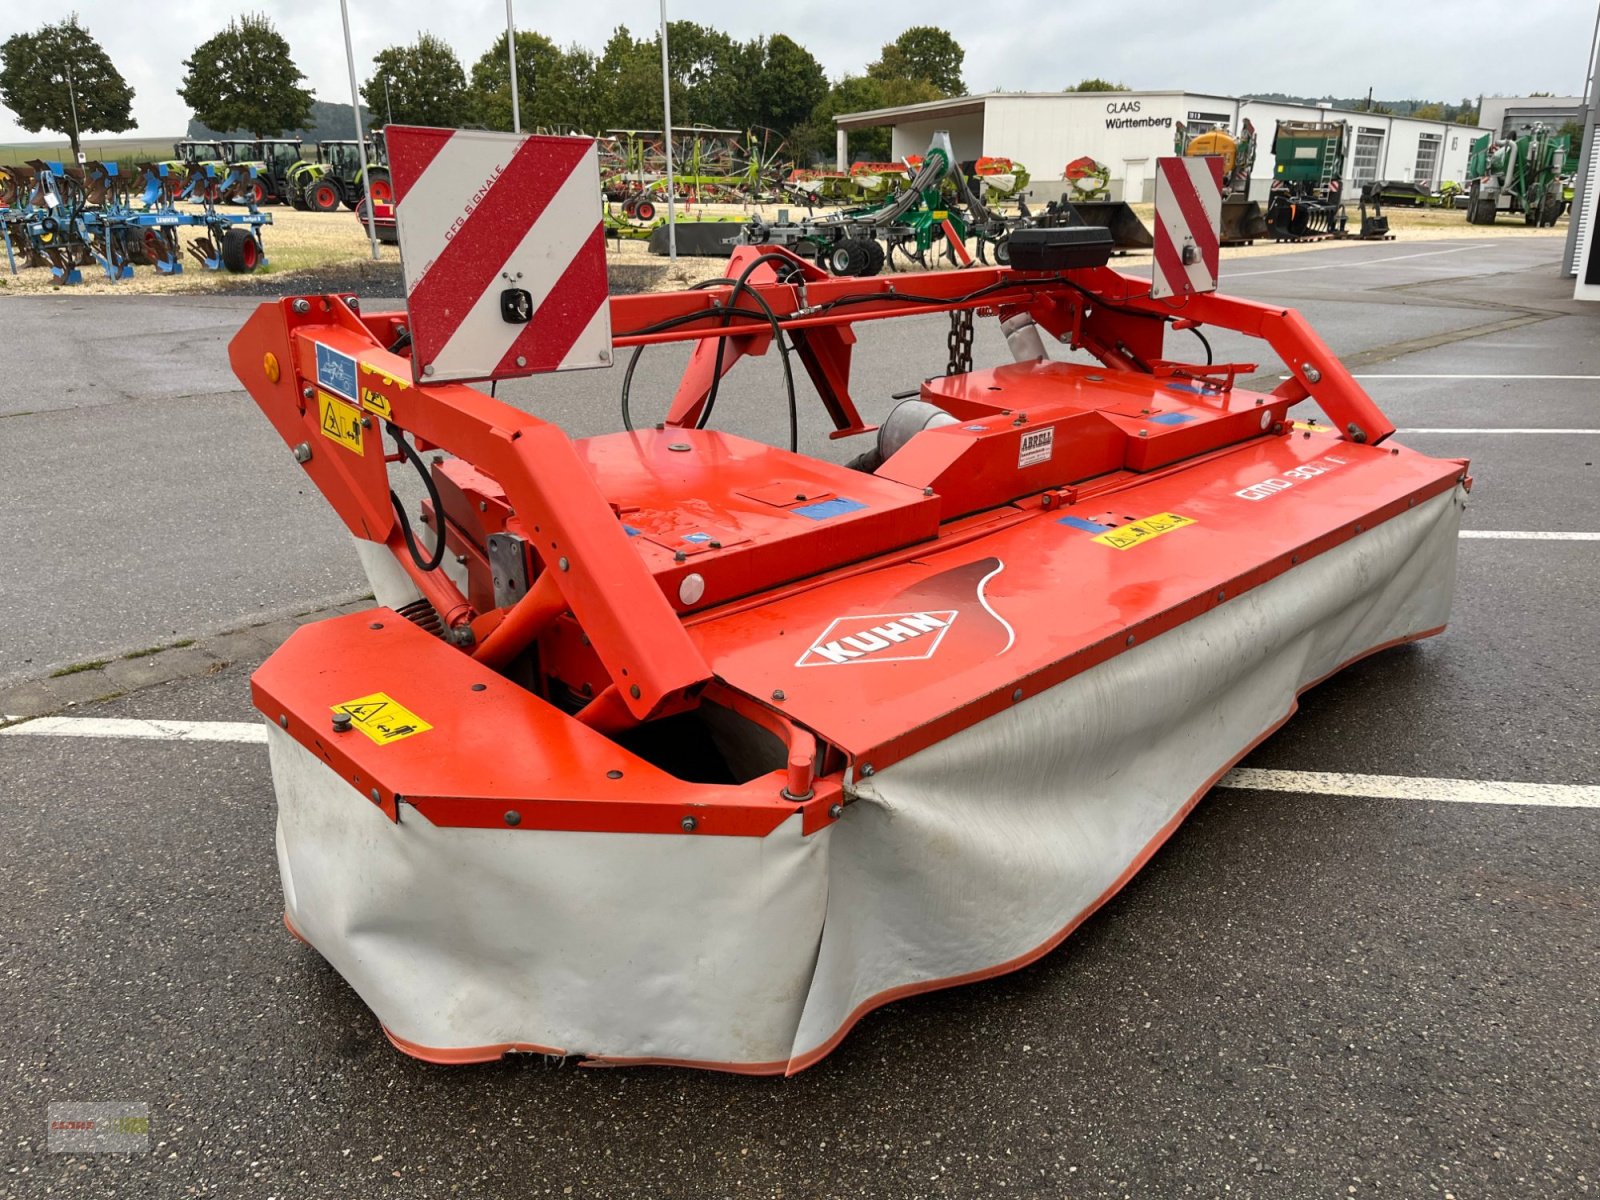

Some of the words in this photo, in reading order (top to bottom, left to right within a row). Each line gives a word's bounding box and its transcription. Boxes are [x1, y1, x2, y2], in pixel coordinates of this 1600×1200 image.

[1106, 101, 1141, 114] CLAAS
[1105, 116, 1172, 129] Württemberg
[444, 216, 465, 241] CFG
[1021, 431, 1052, 452] ABRELL
[1234, 478, 1294, 501] GMD
[810, 613, 949, 663] KUHN
